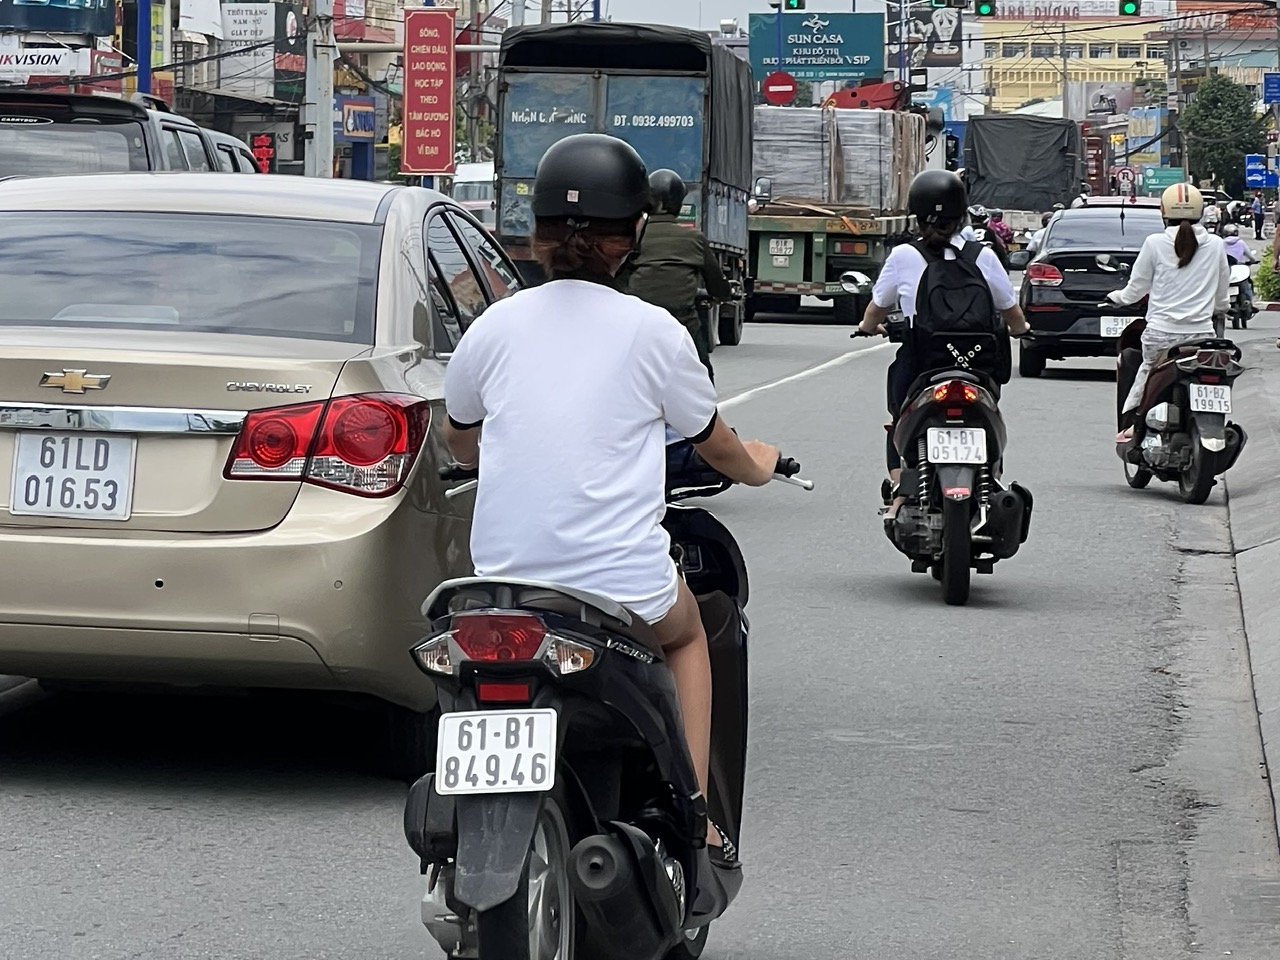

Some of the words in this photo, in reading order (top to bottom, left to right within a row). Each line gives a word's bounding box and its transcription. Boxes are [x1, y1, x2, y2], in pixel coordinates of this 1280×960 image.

[787, 34, 811, 44] SUN
[812, 34, 844, 44] CASA
[420, 95, 438, 104] THEO
[225, 381, 313, 395] CHEVROLET
[1197, 386, 1225, 400] 61-B2
[1194, 398, 1230, 412] 199.15
[937, 430, 975, 446] 61-B1
[39, 436, 110, 472] 61LD
[932, 446, 982, 461] 051.74
[24, 474, 118, 511] 016.53
[457, 716, 536, 752] 61-B1
[444, 753, 547, 789] 849.46
